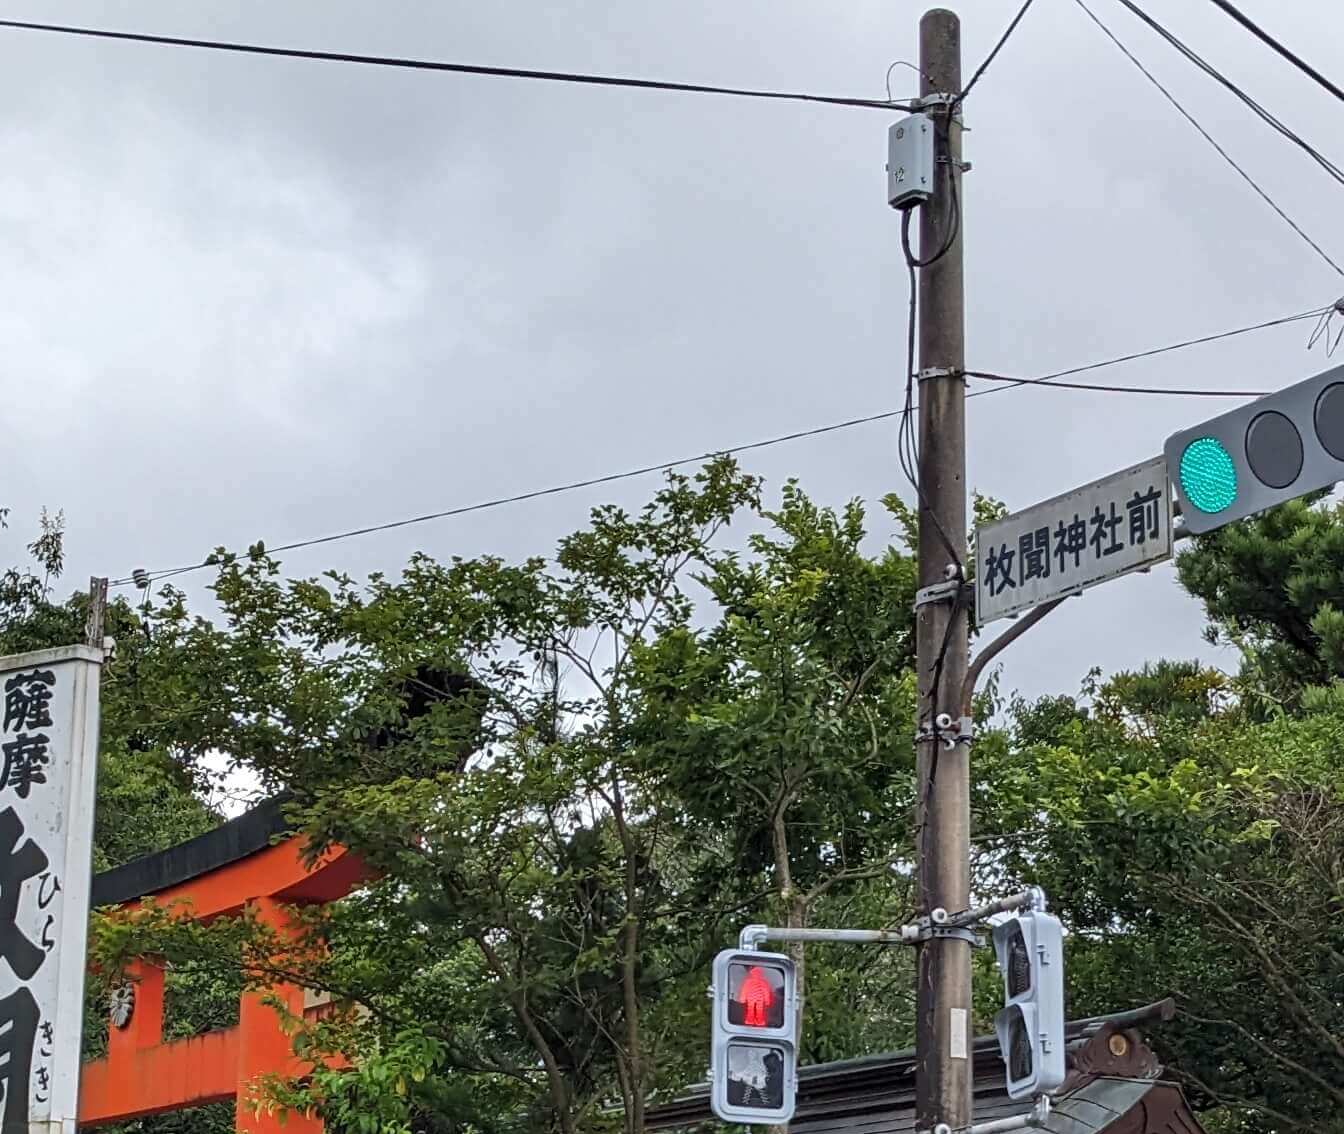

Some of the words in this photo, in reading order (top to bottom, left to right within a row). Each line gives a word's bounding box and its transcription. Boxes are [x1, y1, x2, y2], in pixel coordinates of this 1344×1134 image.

[984, 486, 1162, 597] 枚聞神社前
